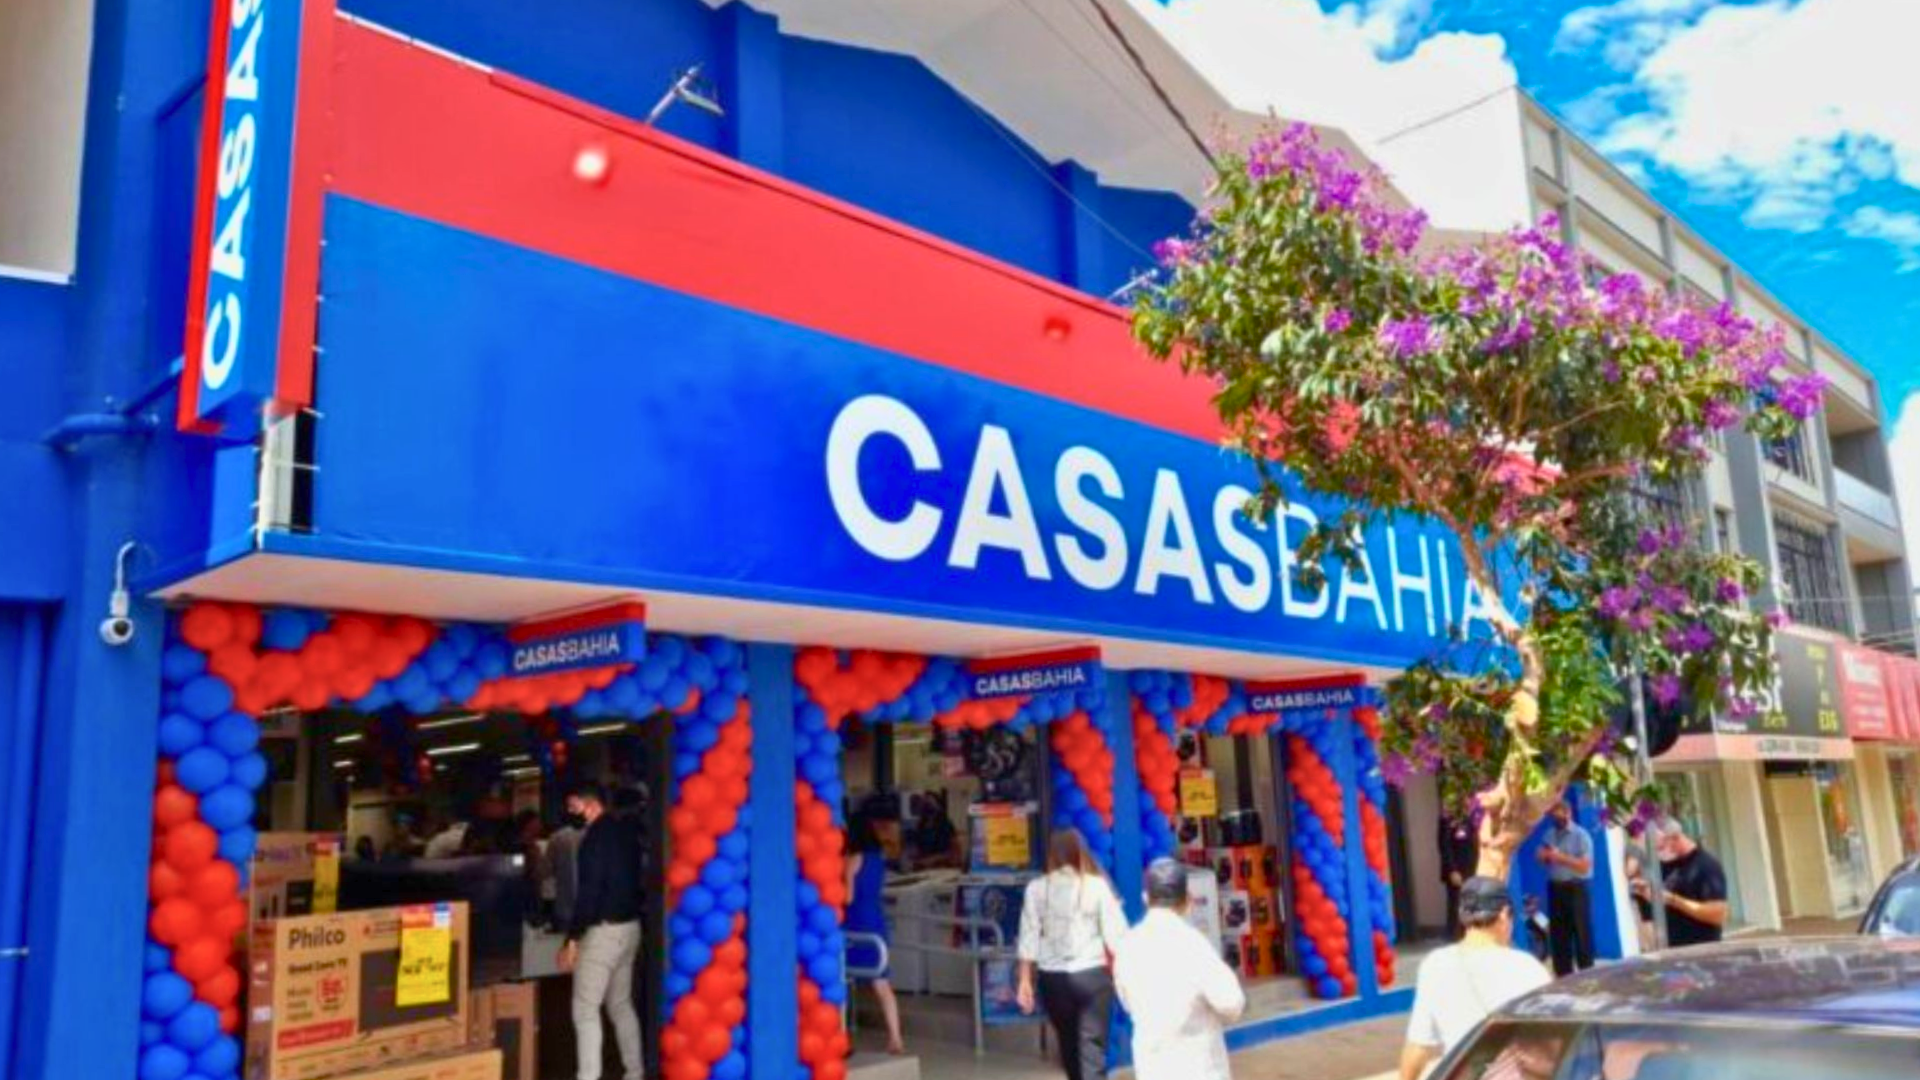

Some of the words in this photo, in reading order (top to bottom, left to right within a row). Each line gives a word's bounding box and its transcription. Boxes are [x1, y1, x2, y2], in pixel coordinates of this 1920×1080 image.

[514, 632, 620, 670] CASASBAHIA
[975, 667, 1085, 695] CASASBAHIA
[1252, 688, 1355, 711] CASASBAHIA
[288, 926, 346, 950] Philco
